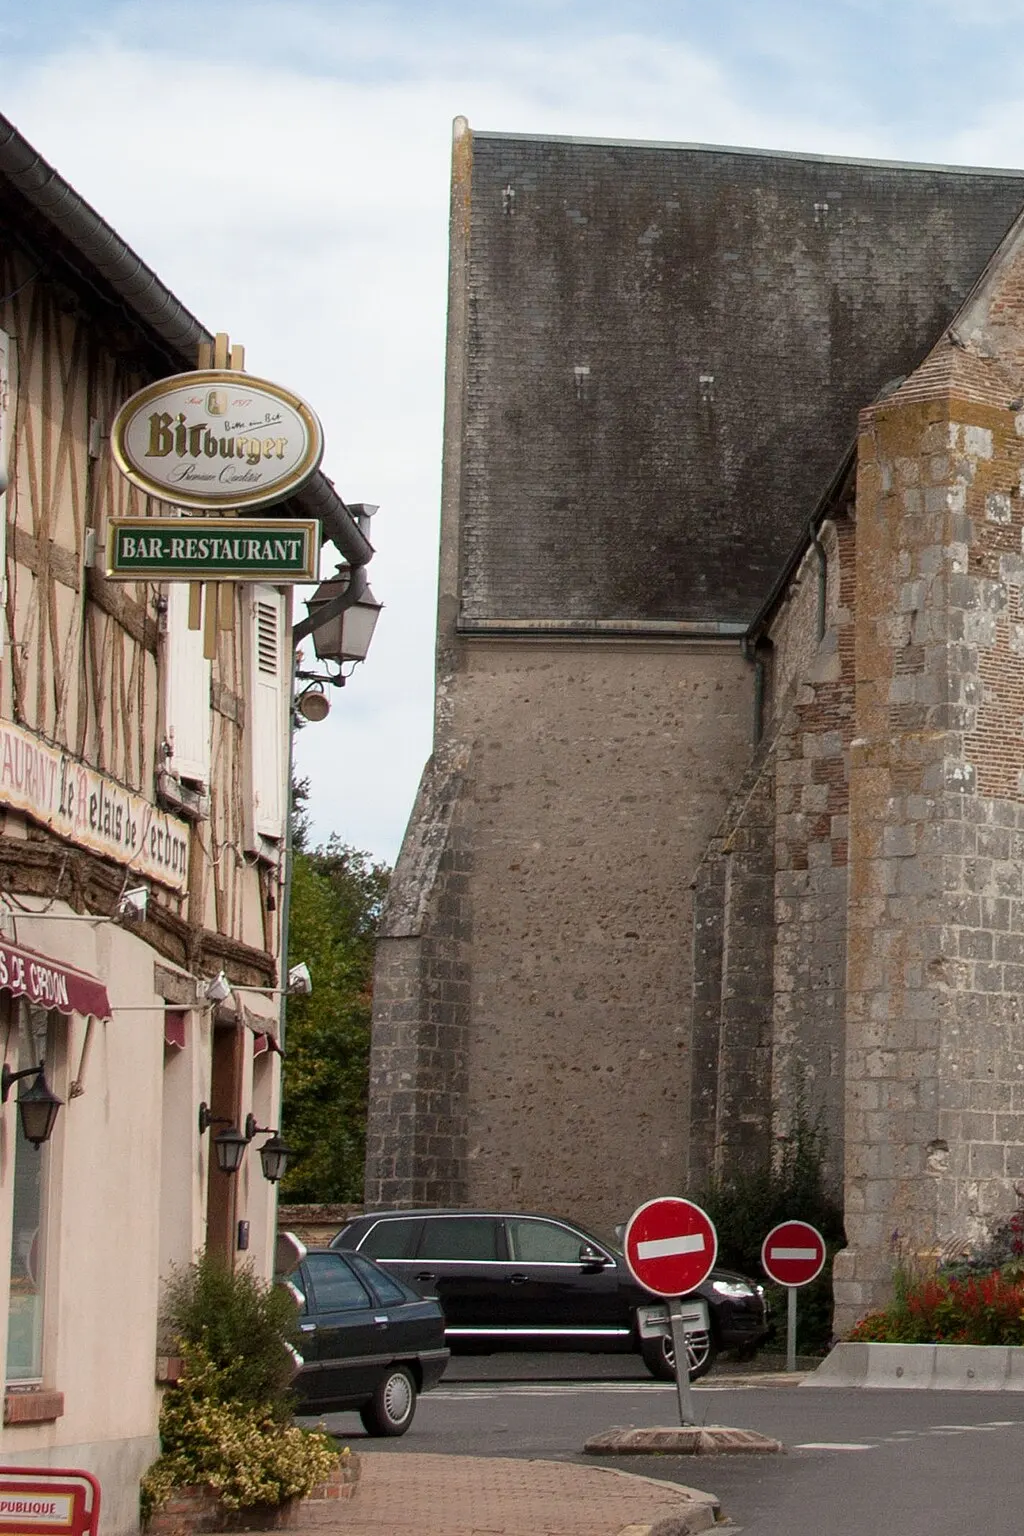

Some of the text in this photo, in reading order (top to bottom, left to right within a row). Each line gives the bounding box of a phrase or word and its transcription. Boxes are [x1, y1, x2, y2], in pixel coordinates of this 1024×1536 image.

[144, 412, 288, 465] Bitburger
[122, 537, 300, 561] BAR-RESTAURANT
[0, 730, 57, 812] AURANT
[12, 955, 27, 990] DE
